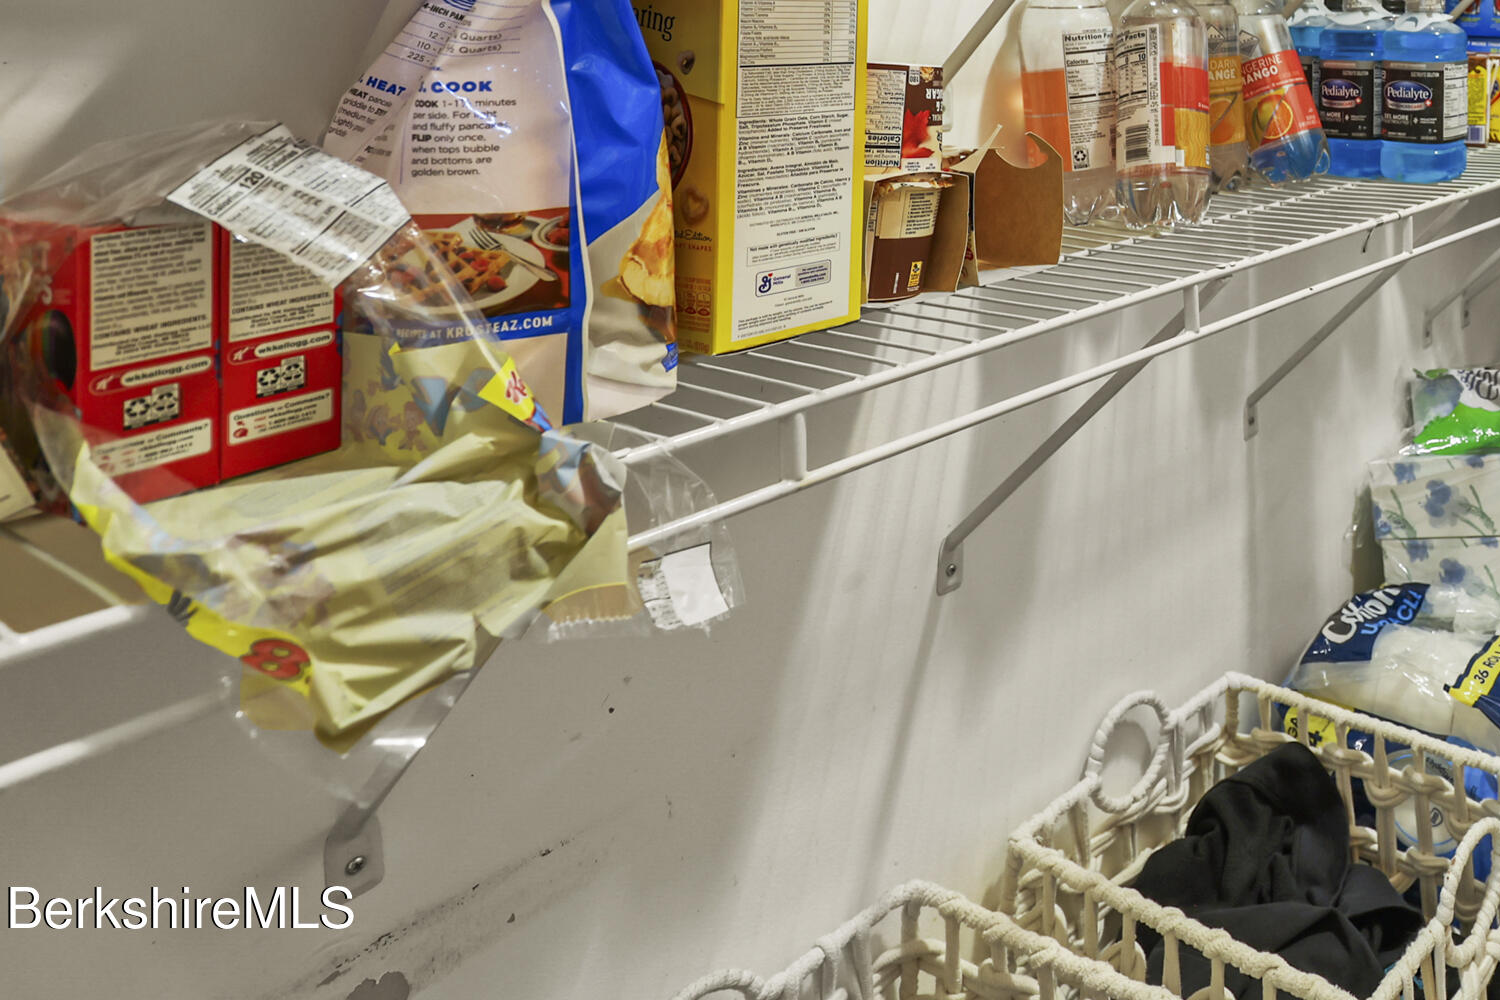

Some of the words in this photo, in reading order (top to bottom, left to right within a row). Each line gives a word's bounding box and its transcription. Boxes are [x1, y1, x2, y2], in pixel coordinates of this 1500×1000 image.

[429, 30, 439, 41] 12
[1064, 31, 1103, 43] Nutrition
[1125, 31, 1146, 41] Facts
[416, 40, 431, 51] 110
[458, 43, 502, 54] Quarts)
[407, 51, 425, 63] 225
[1066, 57, 1089, 66] Calories
[1137, 52, 1146, 62] 10
[366, 76, 407, 97] HEAT
[430, 80, 493, 94] COOK
[1321, 84, 1360, 99] Pedialyte
[1386, 86, 1430, 101] Pedialyte
[426, 110, 448, 120] side.
[452, 110, 470, 119] For
[429, 122, 456, 132] fluffy
[411, 133, 432, 143] FLIP
[433, 133, 456, 144] only
[457, 134, 487, 142] once.
[867, 134, 901, 143] Calories
[411, 146, 437, 154] when
[438, 146, 461, 156] tops
[462, 143, 501, 153] bubble
[411, 156, 430, 165] and
[430, 156, 473, 165] bottoms
[474, 156, 493, 164] are
[865, 158, 900, 167] Nutrition
[411, 167, 445, 178] golden
[446, 167, 481, 177] brown.
[240, 169, 265, 190] 120
[445, 314, 553, 339] KRUSTEAZ.COM
[284, 391, 331, 409] Comments?
[1473, 668, 1490, 685] 36
